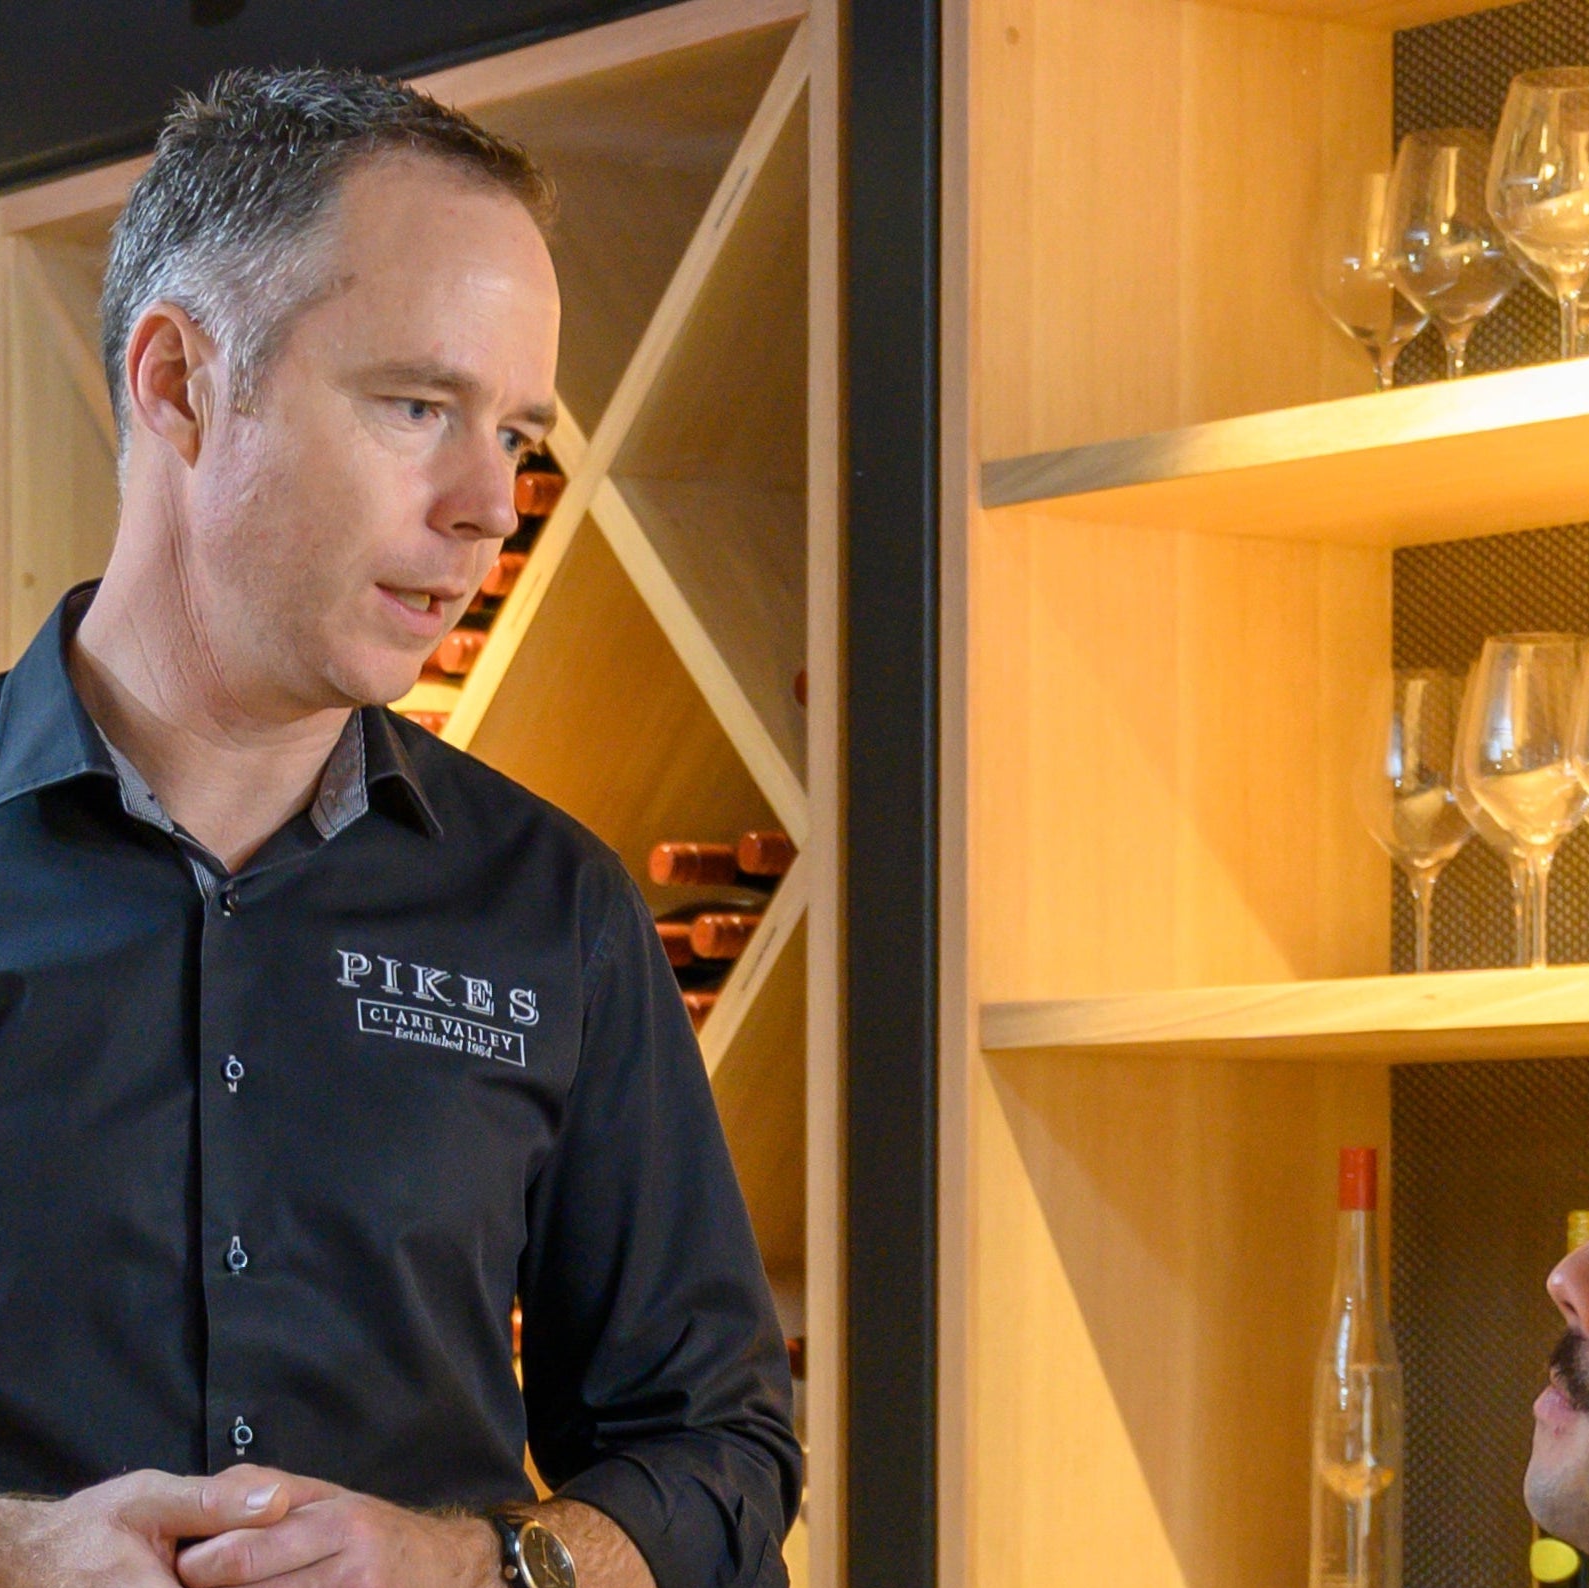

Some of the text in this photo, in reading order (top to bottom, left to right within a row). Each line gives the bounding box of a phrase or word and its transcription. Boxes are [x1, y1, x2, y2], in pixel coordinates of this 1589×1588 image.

[337, 949, 539, 1026] PIKES
[369, 1007, 512, 1051] CLARE VALLEY
[394, 1026, 463, 1051] Established
